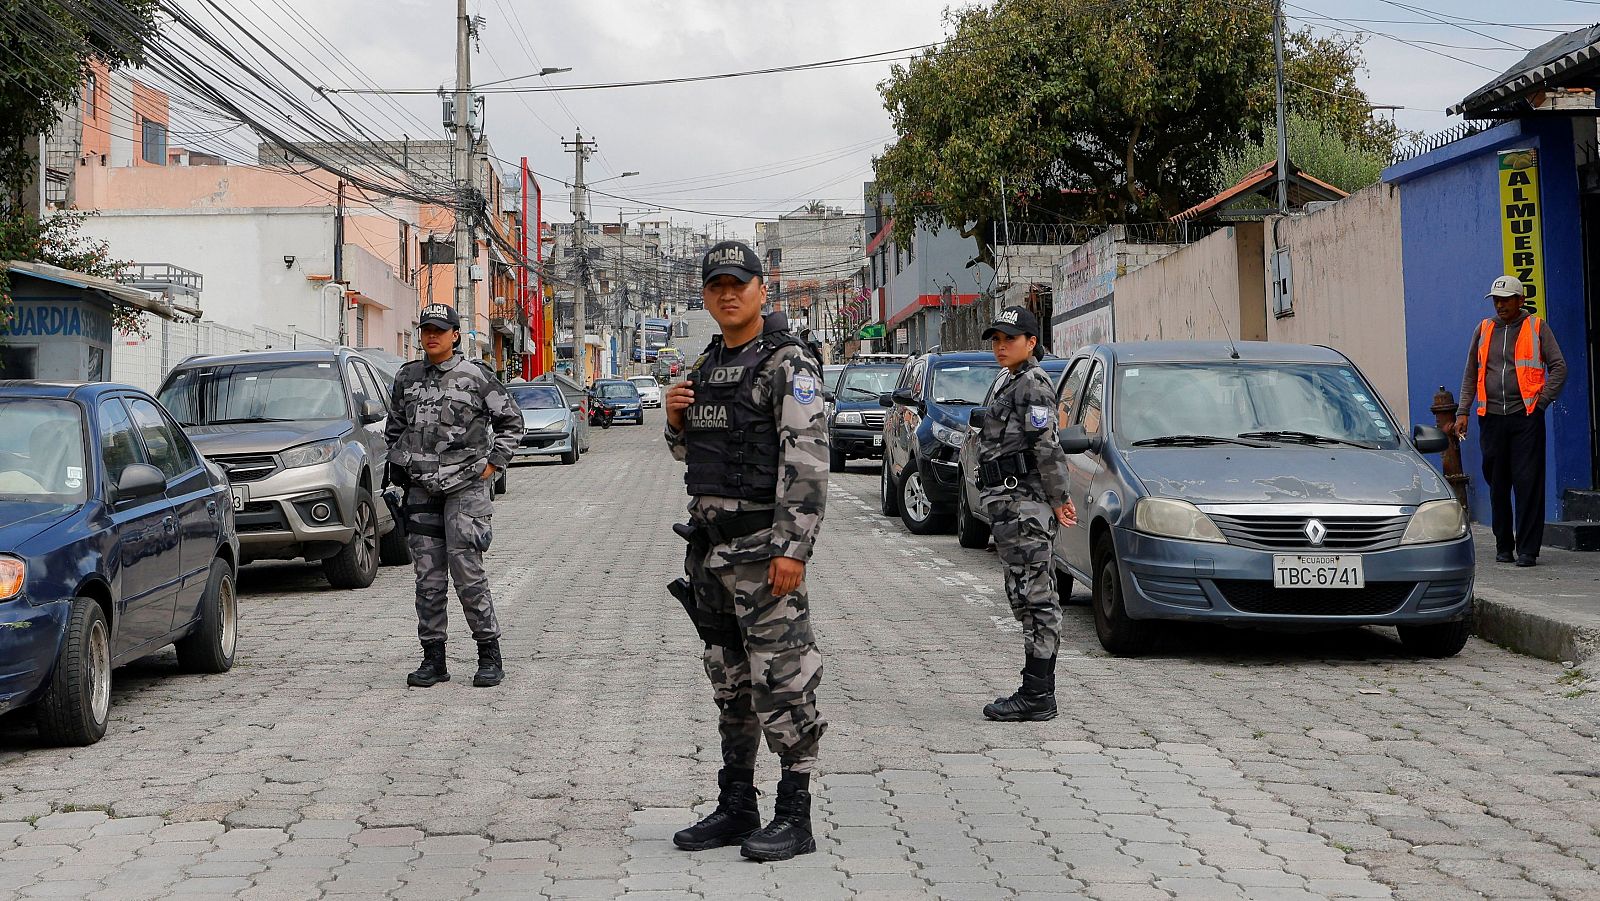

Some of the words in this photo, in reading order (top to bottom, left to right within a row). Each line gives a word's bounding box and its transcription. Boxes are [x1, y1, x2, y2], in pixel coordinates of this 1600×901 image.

[684, 404, 728, 421] OLICIA
[691, 418, 729, 429] NACIONAL
[1277, 567, 1358, 586] TBC-6741
